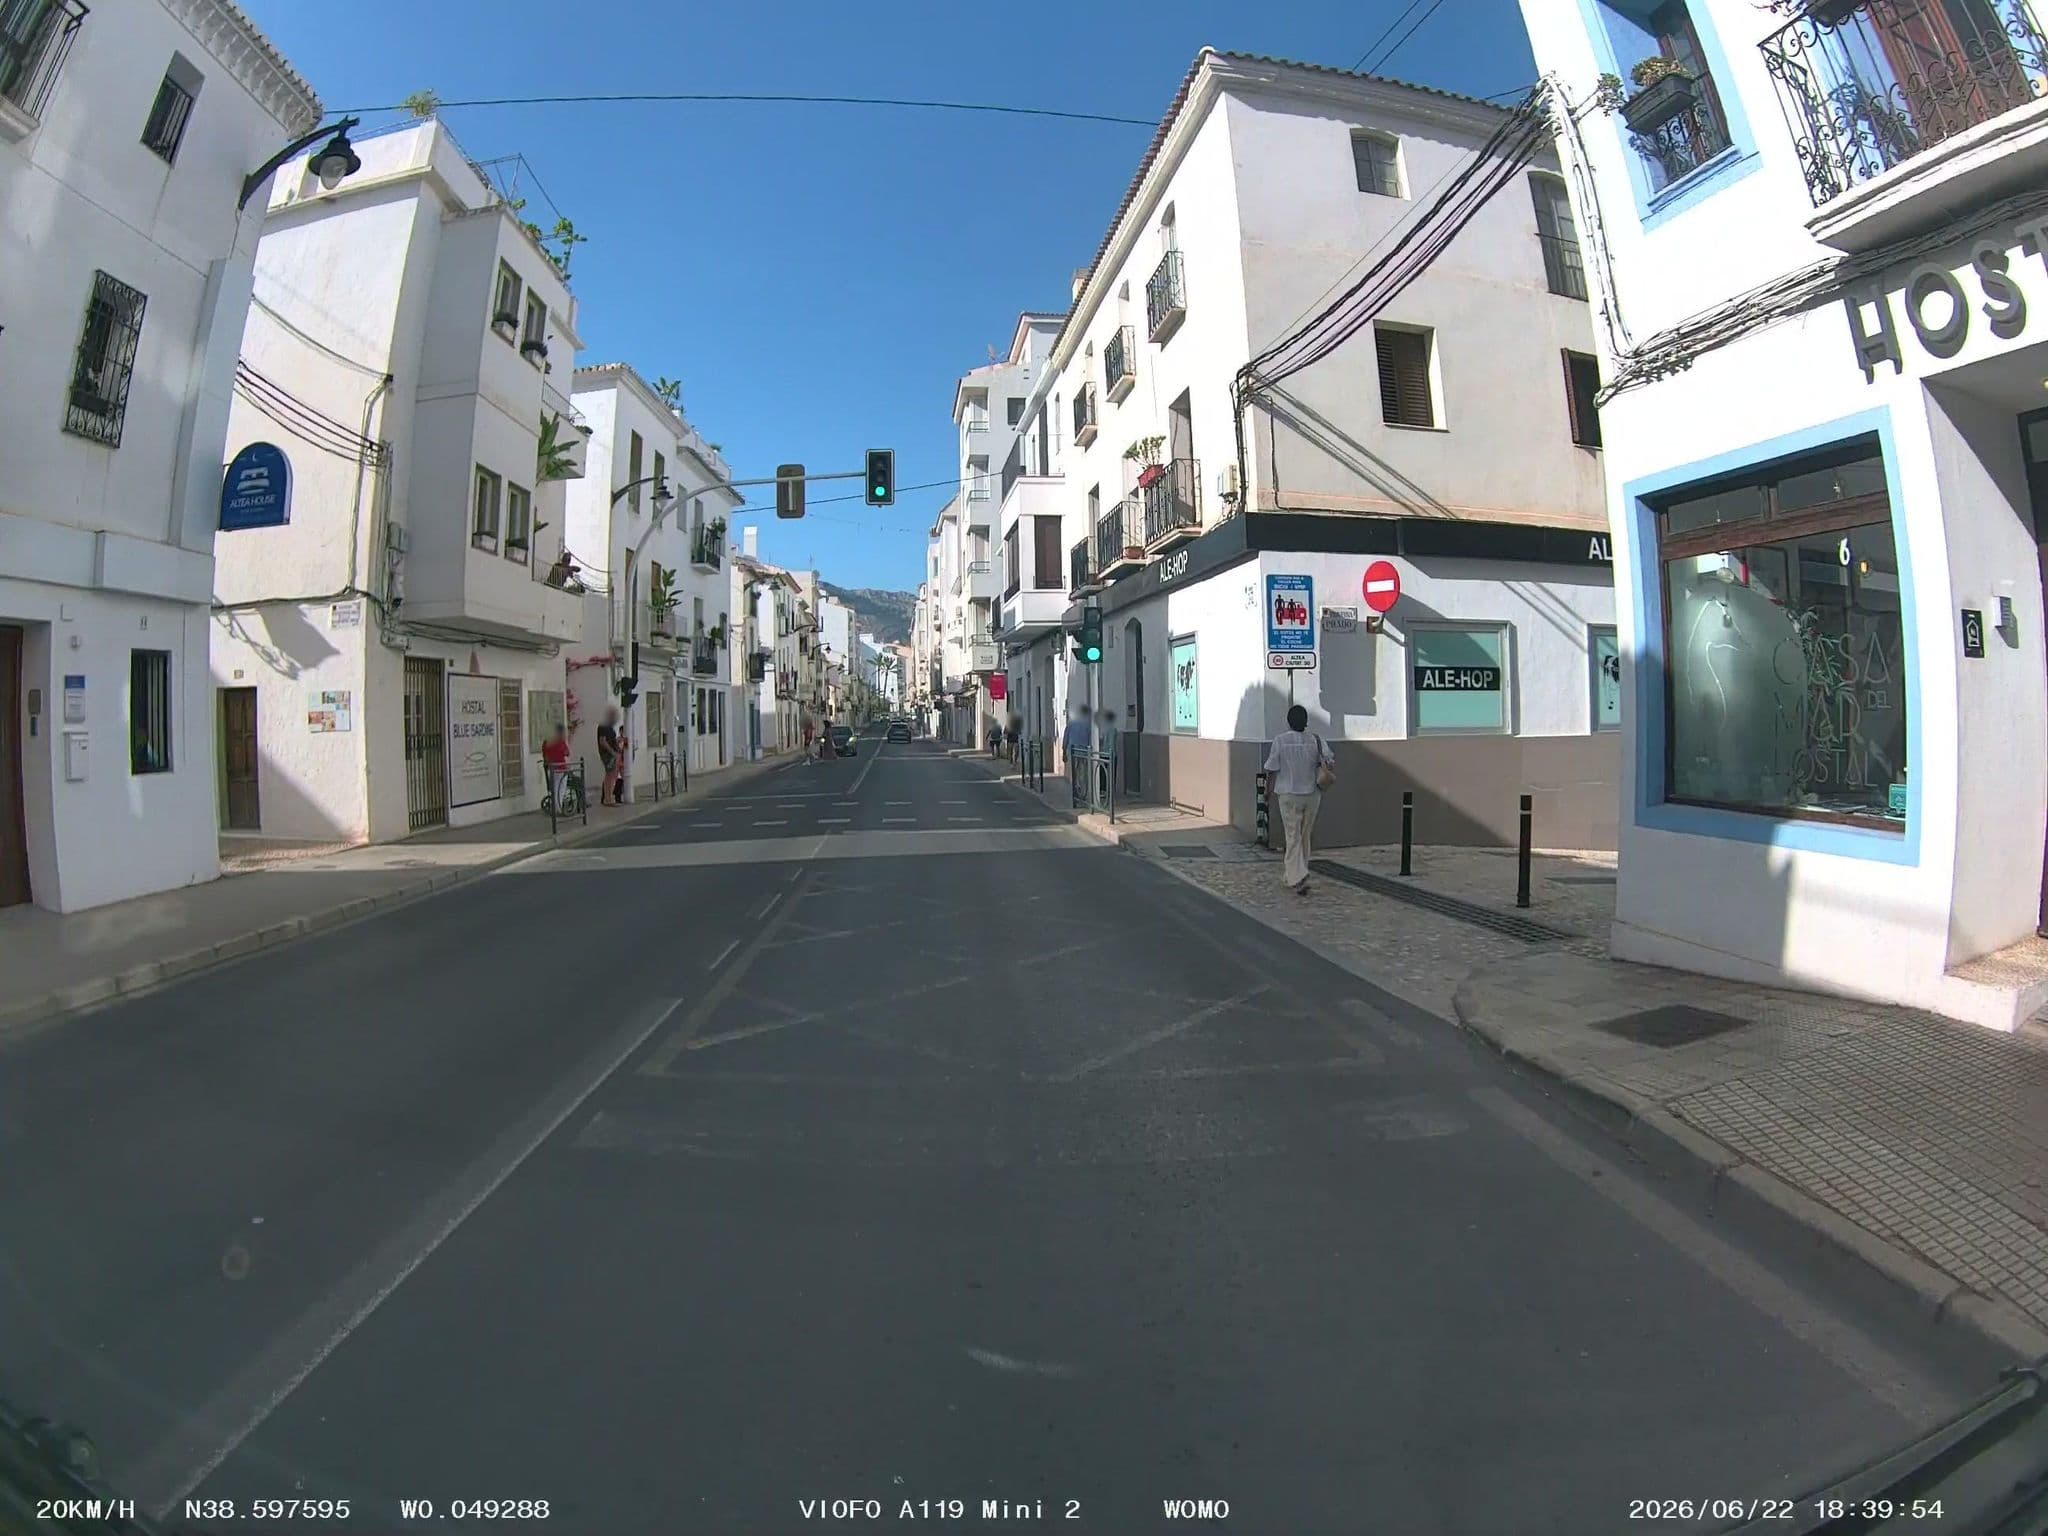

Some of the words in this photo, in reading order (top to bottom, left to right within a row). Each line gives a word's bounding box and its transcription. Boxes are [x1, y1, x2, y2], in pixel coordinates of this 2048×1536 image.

[229, 497, 250, 508] ALTEA
[251, 495, 276, 506] HOUSE
[1839, 536, 1850, 566] 6
[1160, 550, 1188, 583] ALE-HOP
[1772, 632, 1892, 686] CASA
[1422, 669, 1493, 688] ALE-HOP
[461, 699, 487, 715] HOSTAL
[1867, 689, 1892, 709] DEL
[1774, 690, 1863, 744] MAR
[453, 722, 470, 738] BLUE
[471, 721, 495, 737] SARDINE
